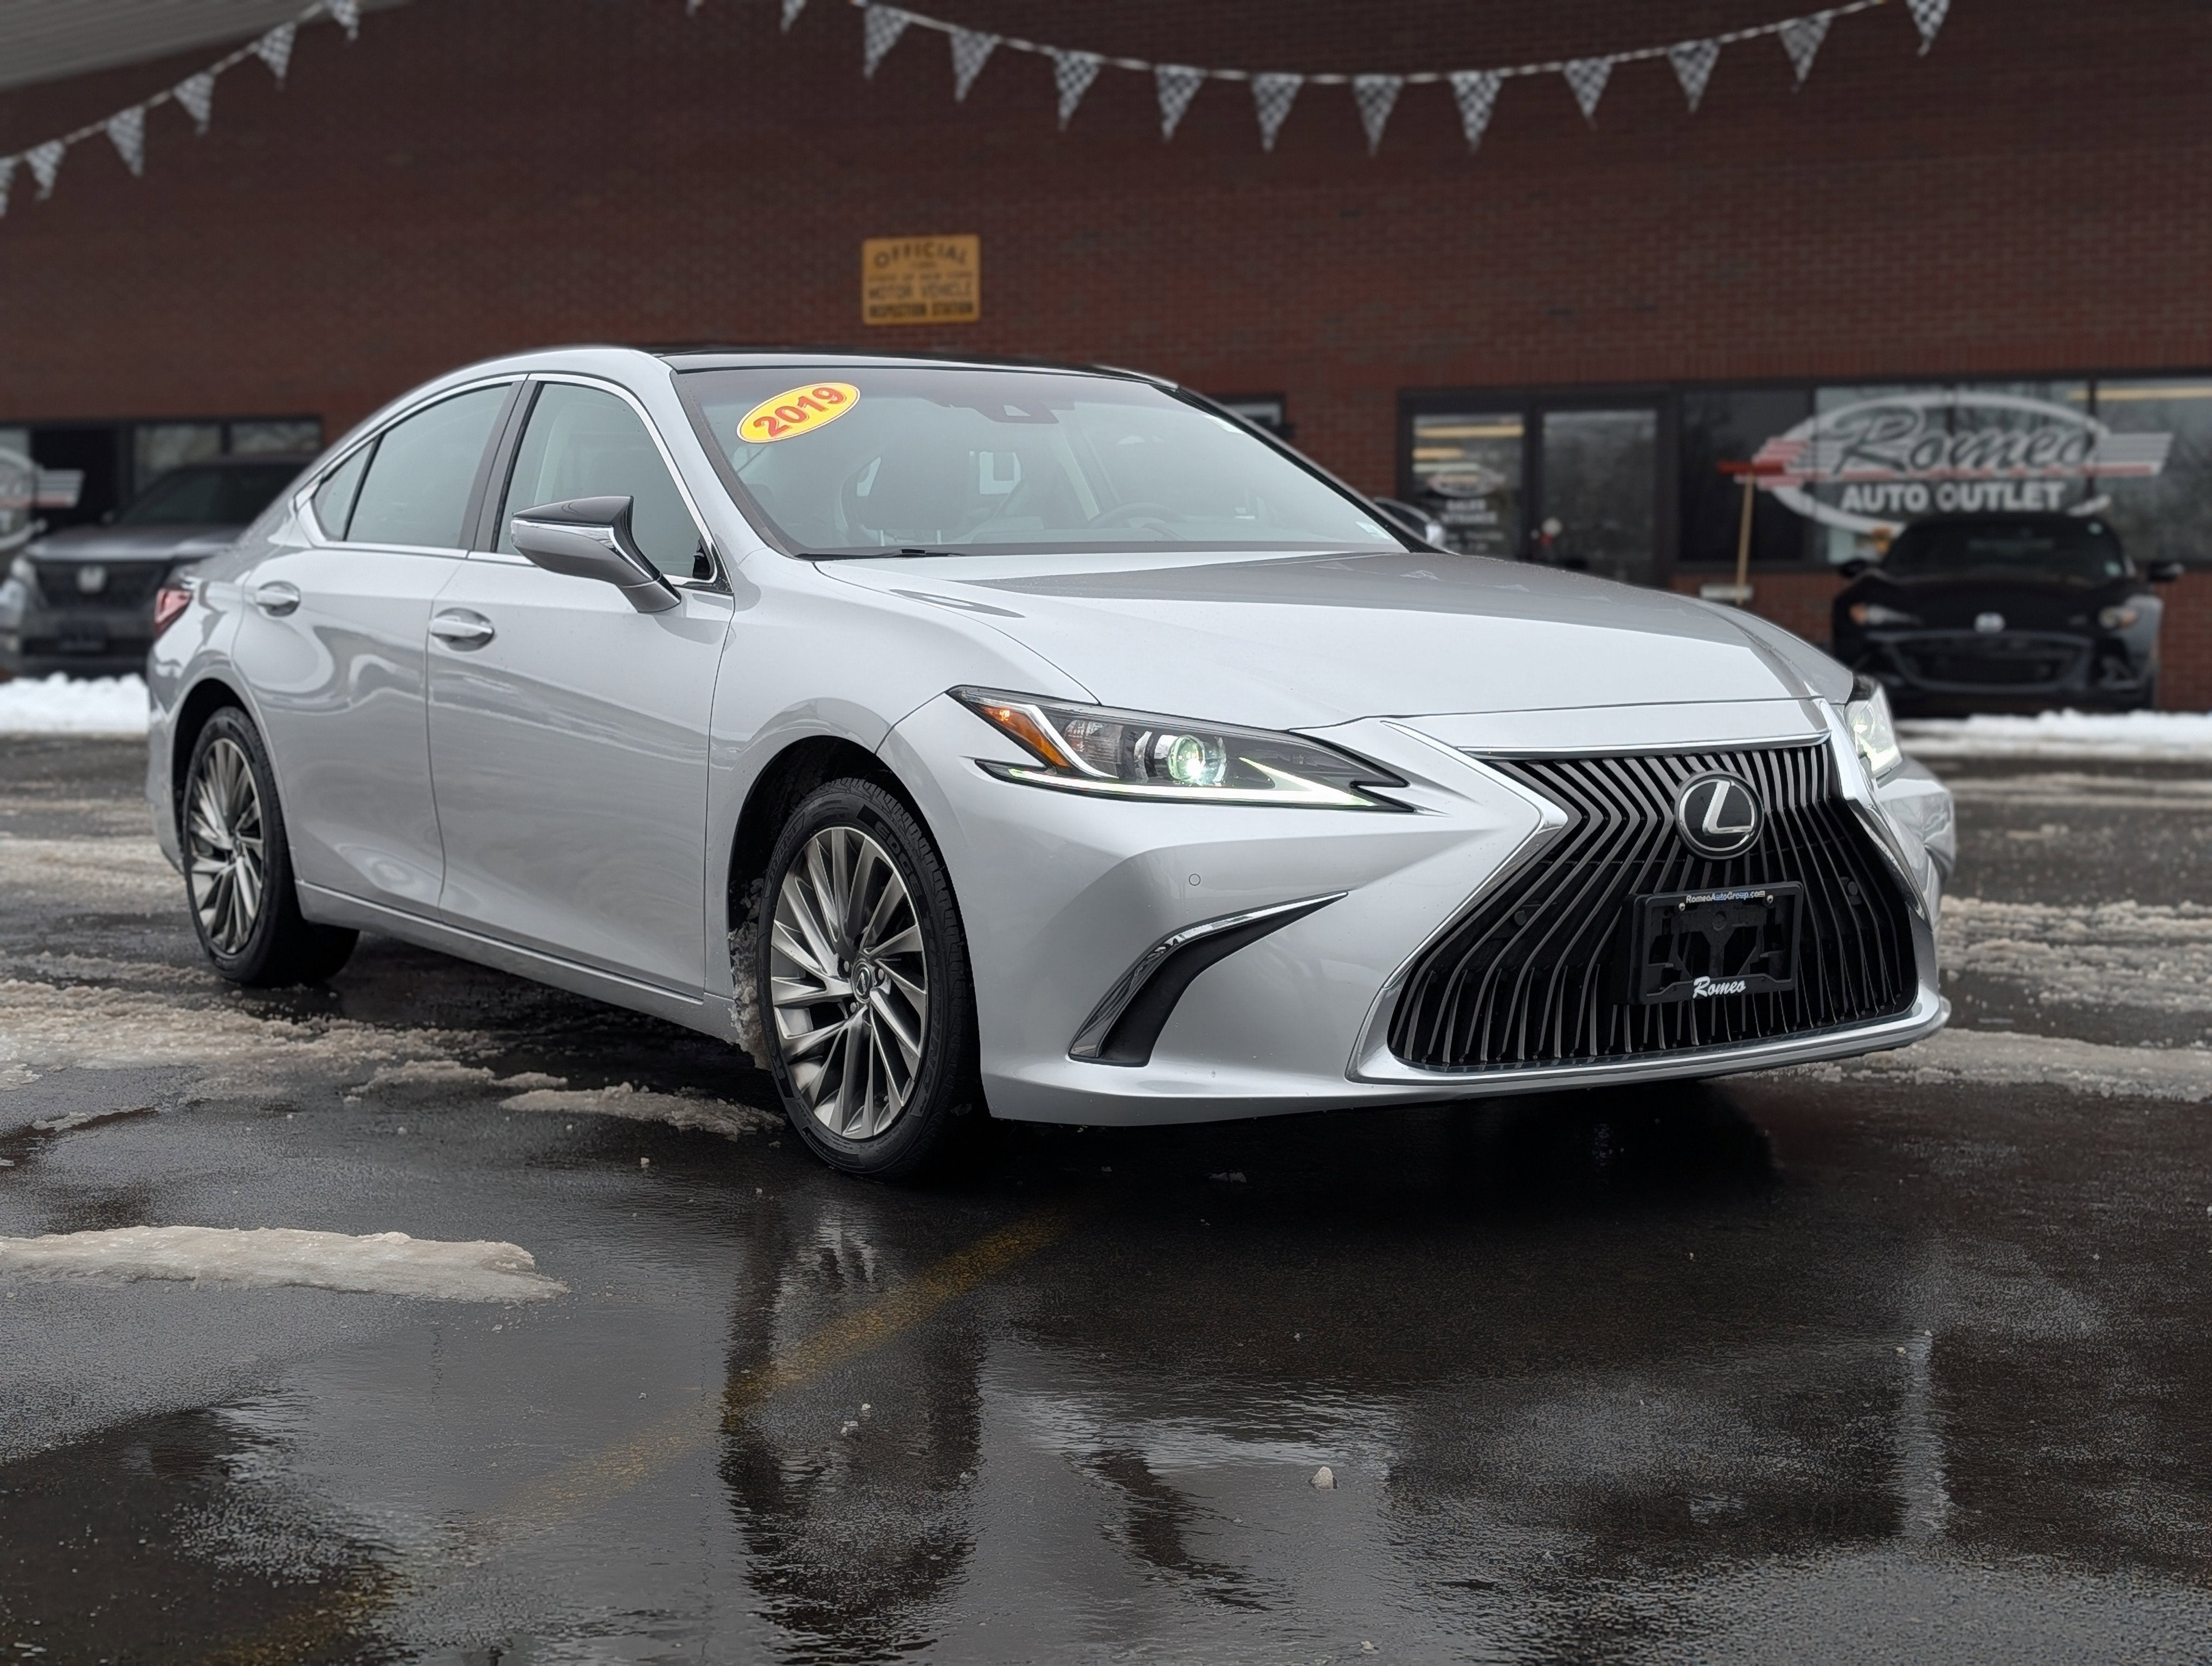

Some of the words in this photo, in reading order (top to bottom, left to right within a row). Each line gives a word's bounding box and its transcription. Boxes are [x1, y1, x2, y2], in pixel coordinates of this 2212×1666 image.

[753, 387, 847, 437] 2019
[1832, 406, 2095, 475] Romeo
[1842, 482, 1929, 512] AUTO
[1935, 480, 2067, 512] OUTLET
[1686, 890, 1765, 904] RomeoAutoGroup.com
[1693, 976, 1746, 998] Romeo
